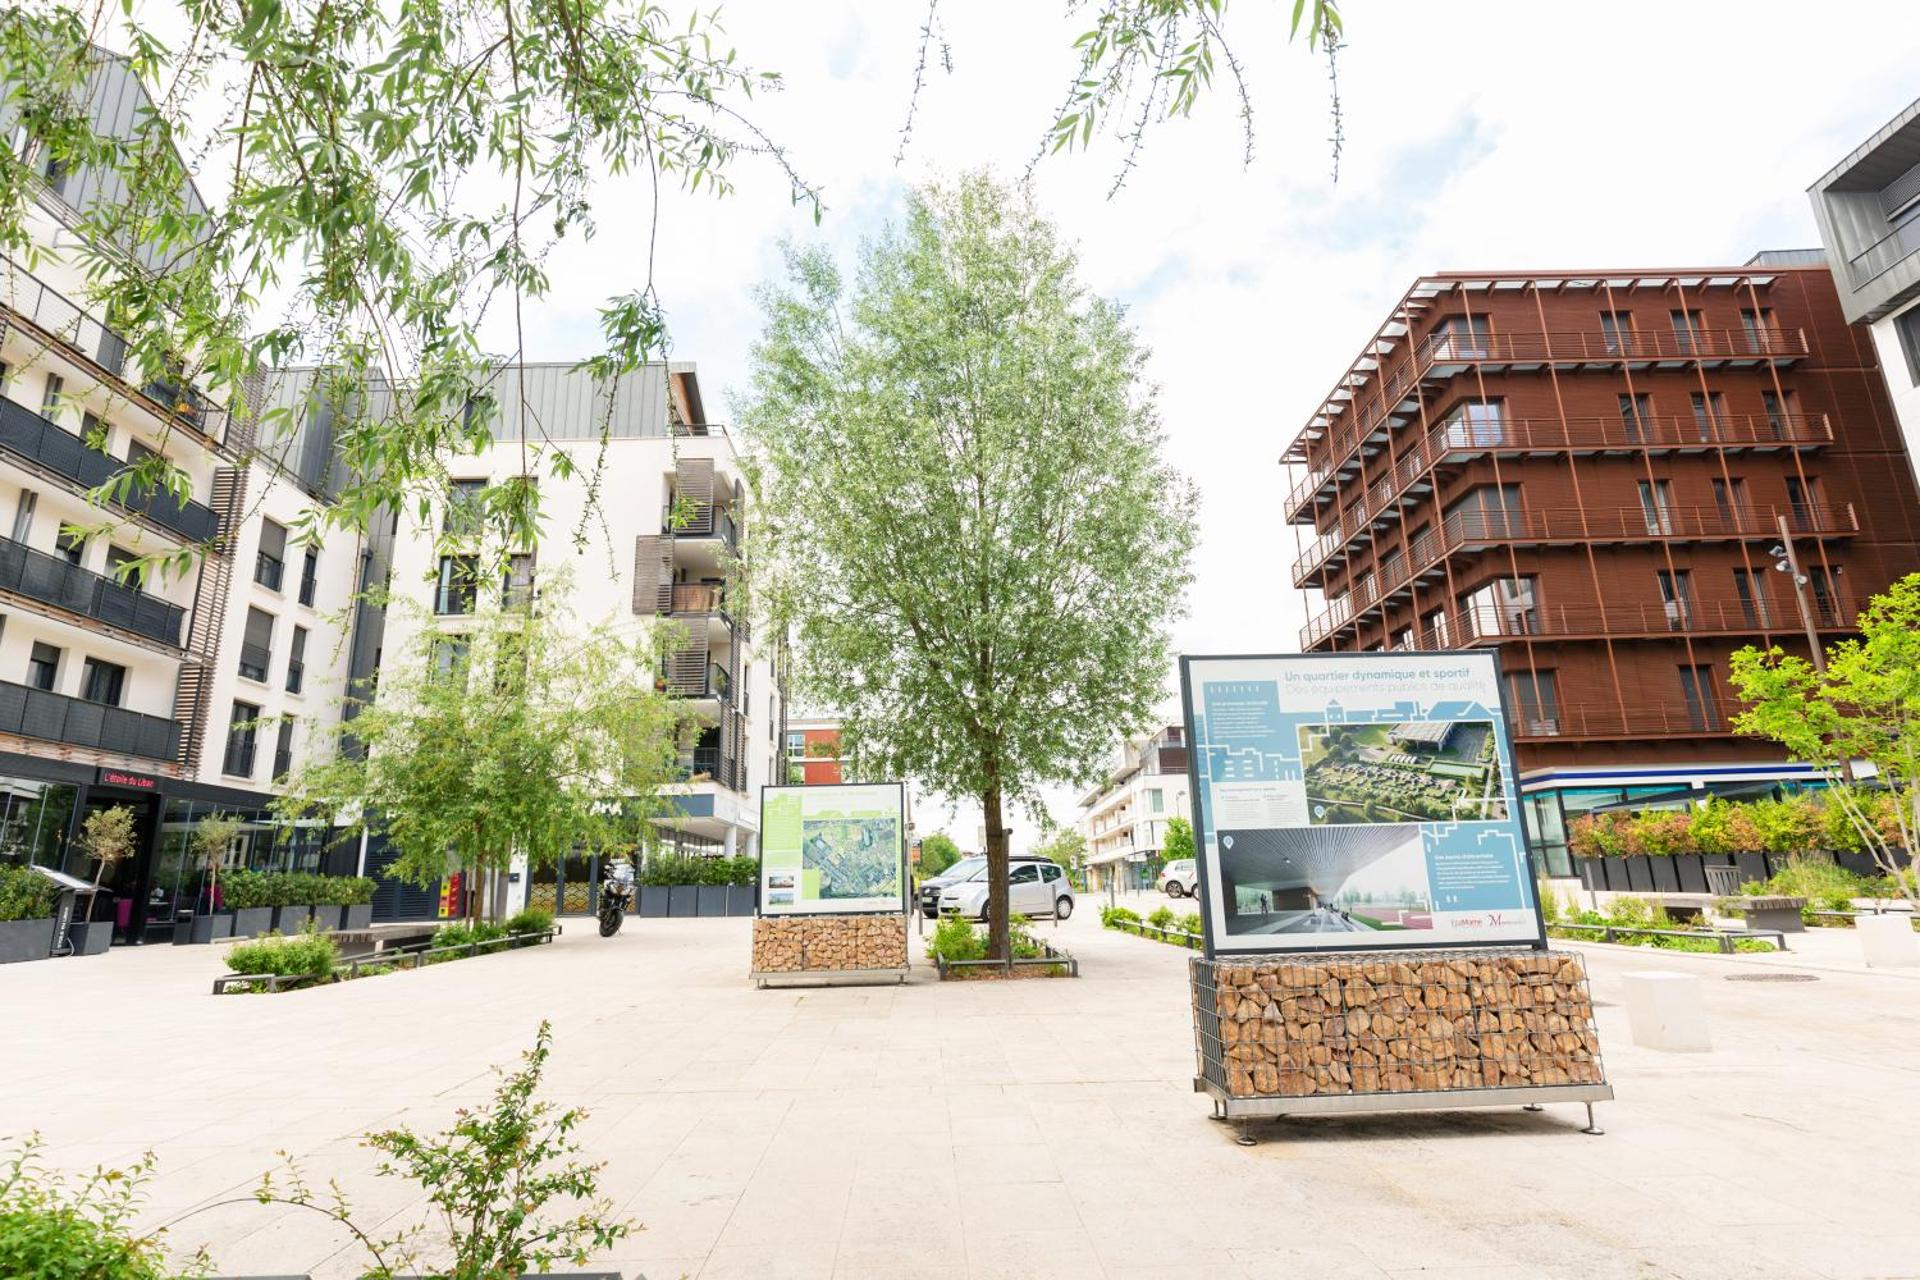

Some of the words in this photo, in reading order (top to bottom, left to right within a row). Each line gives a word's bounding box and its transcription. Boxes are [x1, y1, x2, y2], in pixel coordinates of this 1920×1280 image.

[1285, 671, 1300, 681] Un
[1303, 671, 1349, 682] quartier
[1352, 669, 1415, 682] dynamique
[1418, 670, 1430, 679] et
[1433, 668, 1470, 680] sportif
